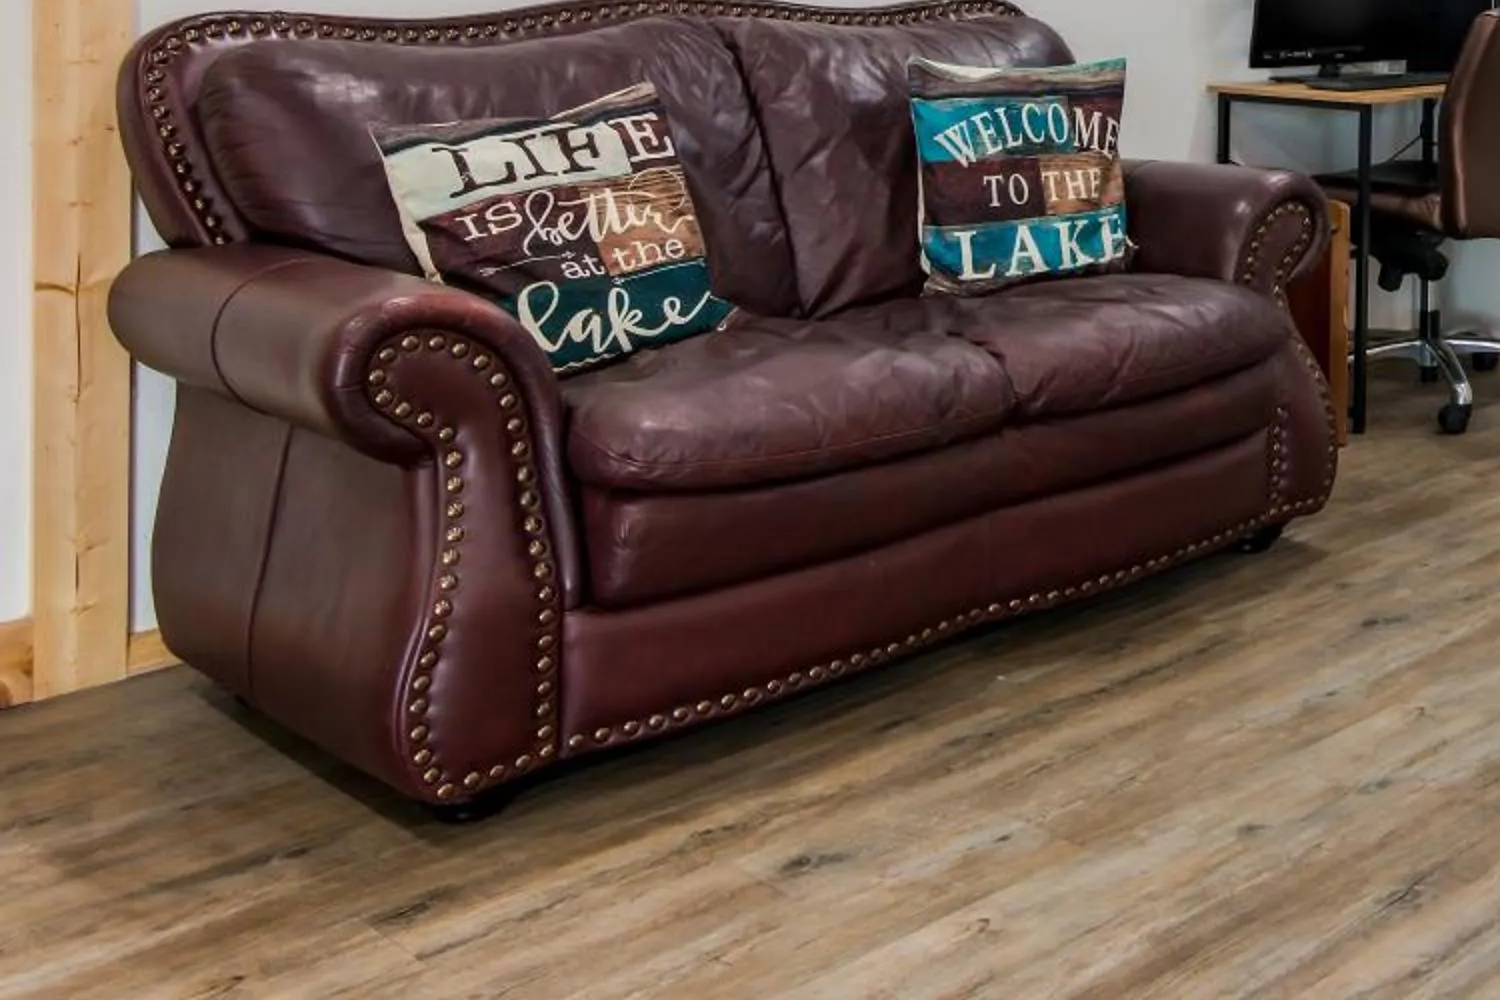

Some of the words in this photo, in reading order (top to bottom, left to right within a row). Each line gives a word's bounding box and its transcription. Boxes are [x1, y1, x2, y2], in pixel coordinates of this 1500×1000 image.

[431, 111, 676, 198] LIFE
[934, 103, 1120, 168] WELCOME
[455, 201, 524, 240] IS
[522, 168, 695, 256] better
[983, 173, 1030, 207] TO
[1041, 167, 1101, 202] THE
[561, 254, 605, 279] at
[613, 239, 686, 272] the
[953, 214, 1126, 281] LAKE
[517, 281, 711, 353] lake
